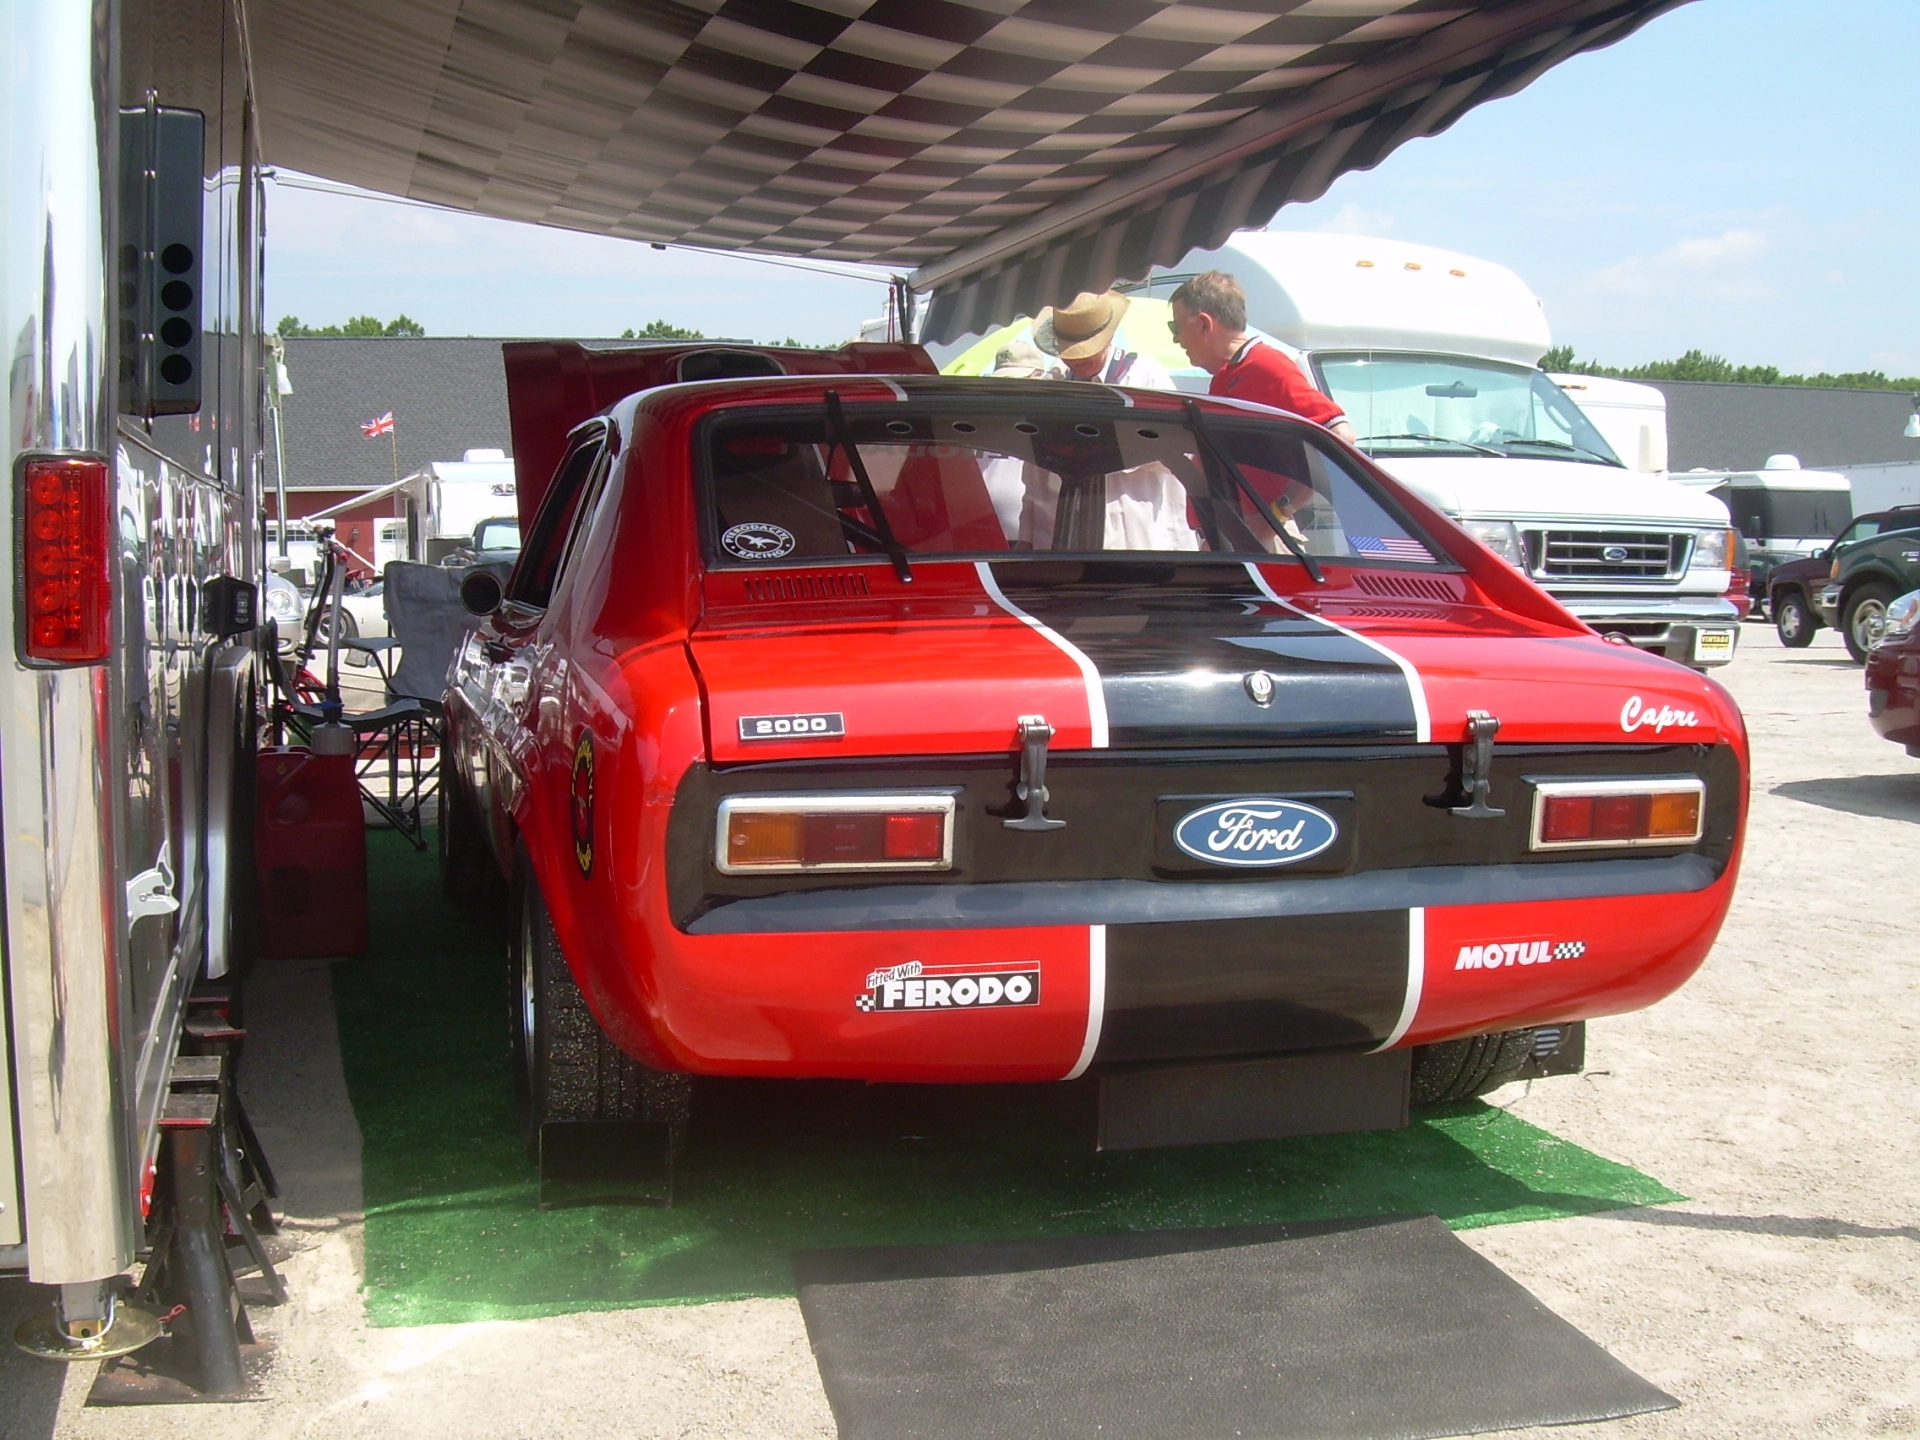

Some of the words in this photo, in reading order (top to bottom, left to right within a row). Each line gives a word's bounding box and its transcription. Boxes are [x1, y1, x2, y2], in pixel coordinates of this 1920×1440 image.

[725, 524, 789, 543] PTERODACTYL
[738, 549, 784, 558] RACING
[756, 718, 827, 733] 2000
[1620, 696, 1699, 734] Capri
[1208, 809, 1306, 851] Ford
[1454, 941, 1553, 970] MOTUL
[867, 969, 895, 987] Fitted
[897, 963, 921, 977] With
[883, 975, 1032, 1007] FERODO
